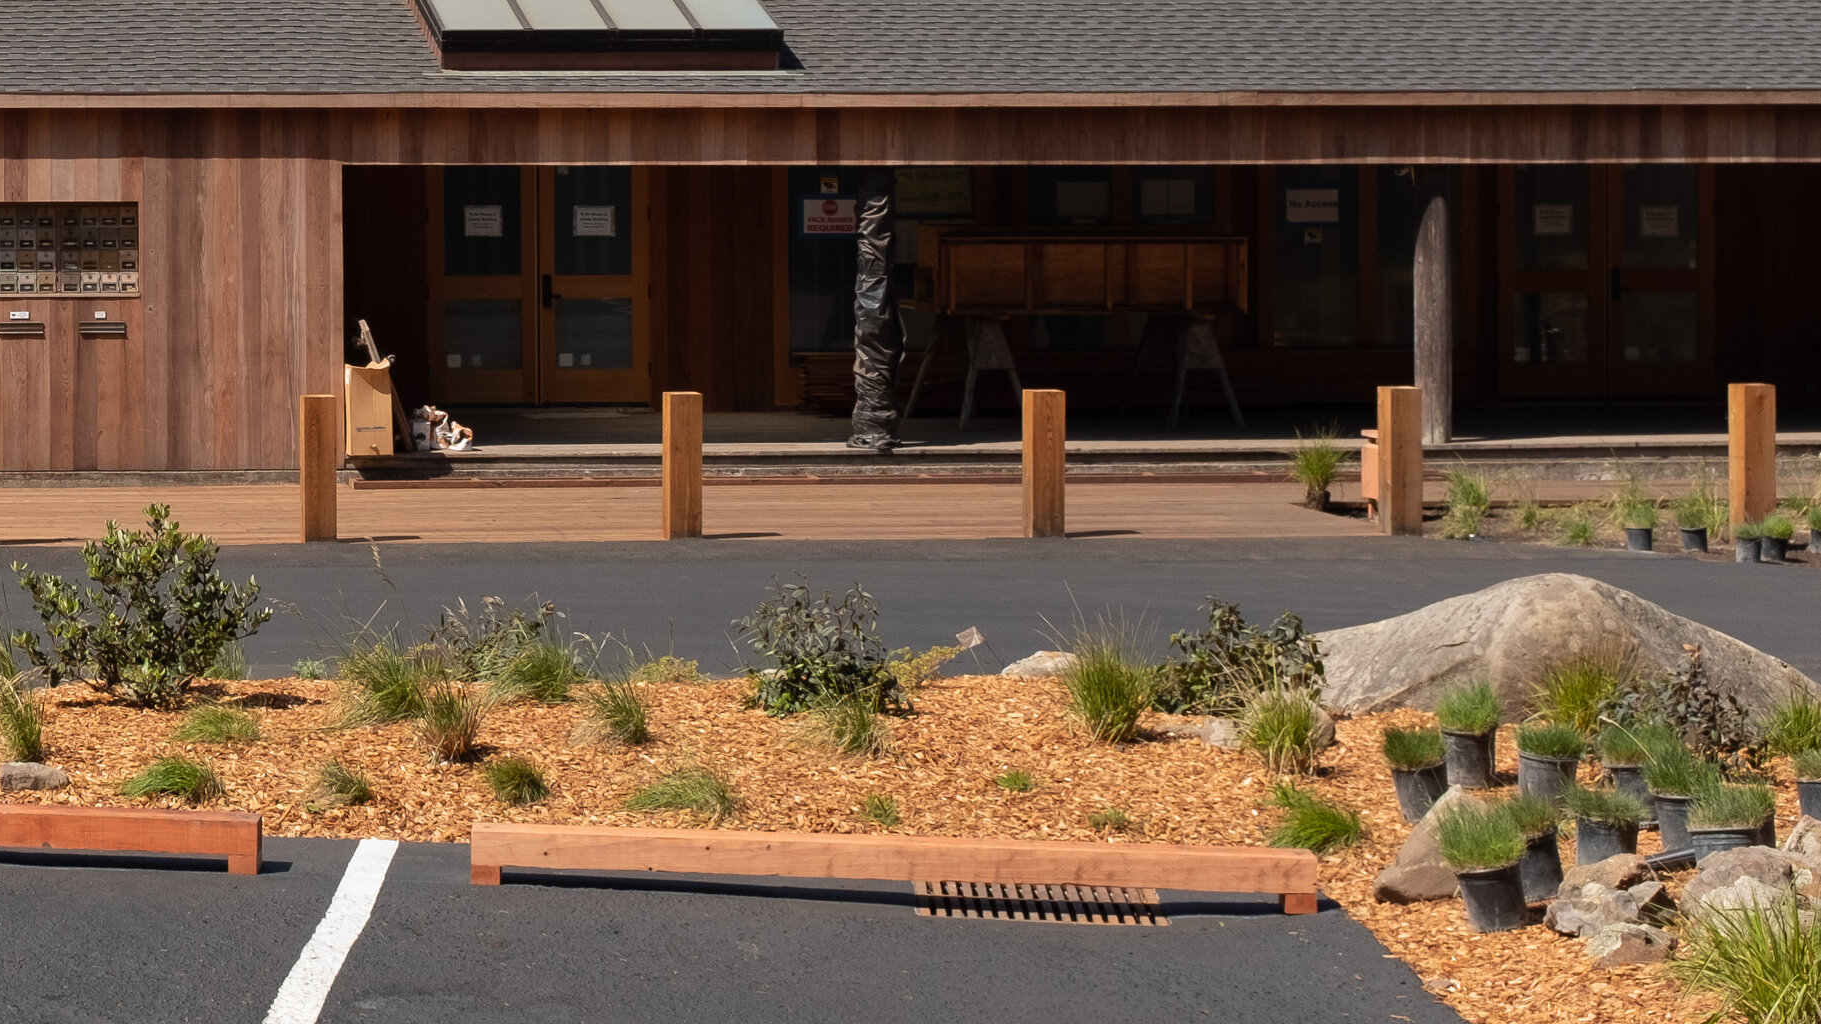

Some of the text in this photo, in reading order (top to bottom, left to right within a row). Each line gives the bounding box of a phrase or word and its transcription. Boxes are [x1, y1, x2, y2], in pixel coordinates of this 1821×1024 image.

[1289, 200, 1339, 208] No Access
[807, 224, 854, 232] REQUIRED
